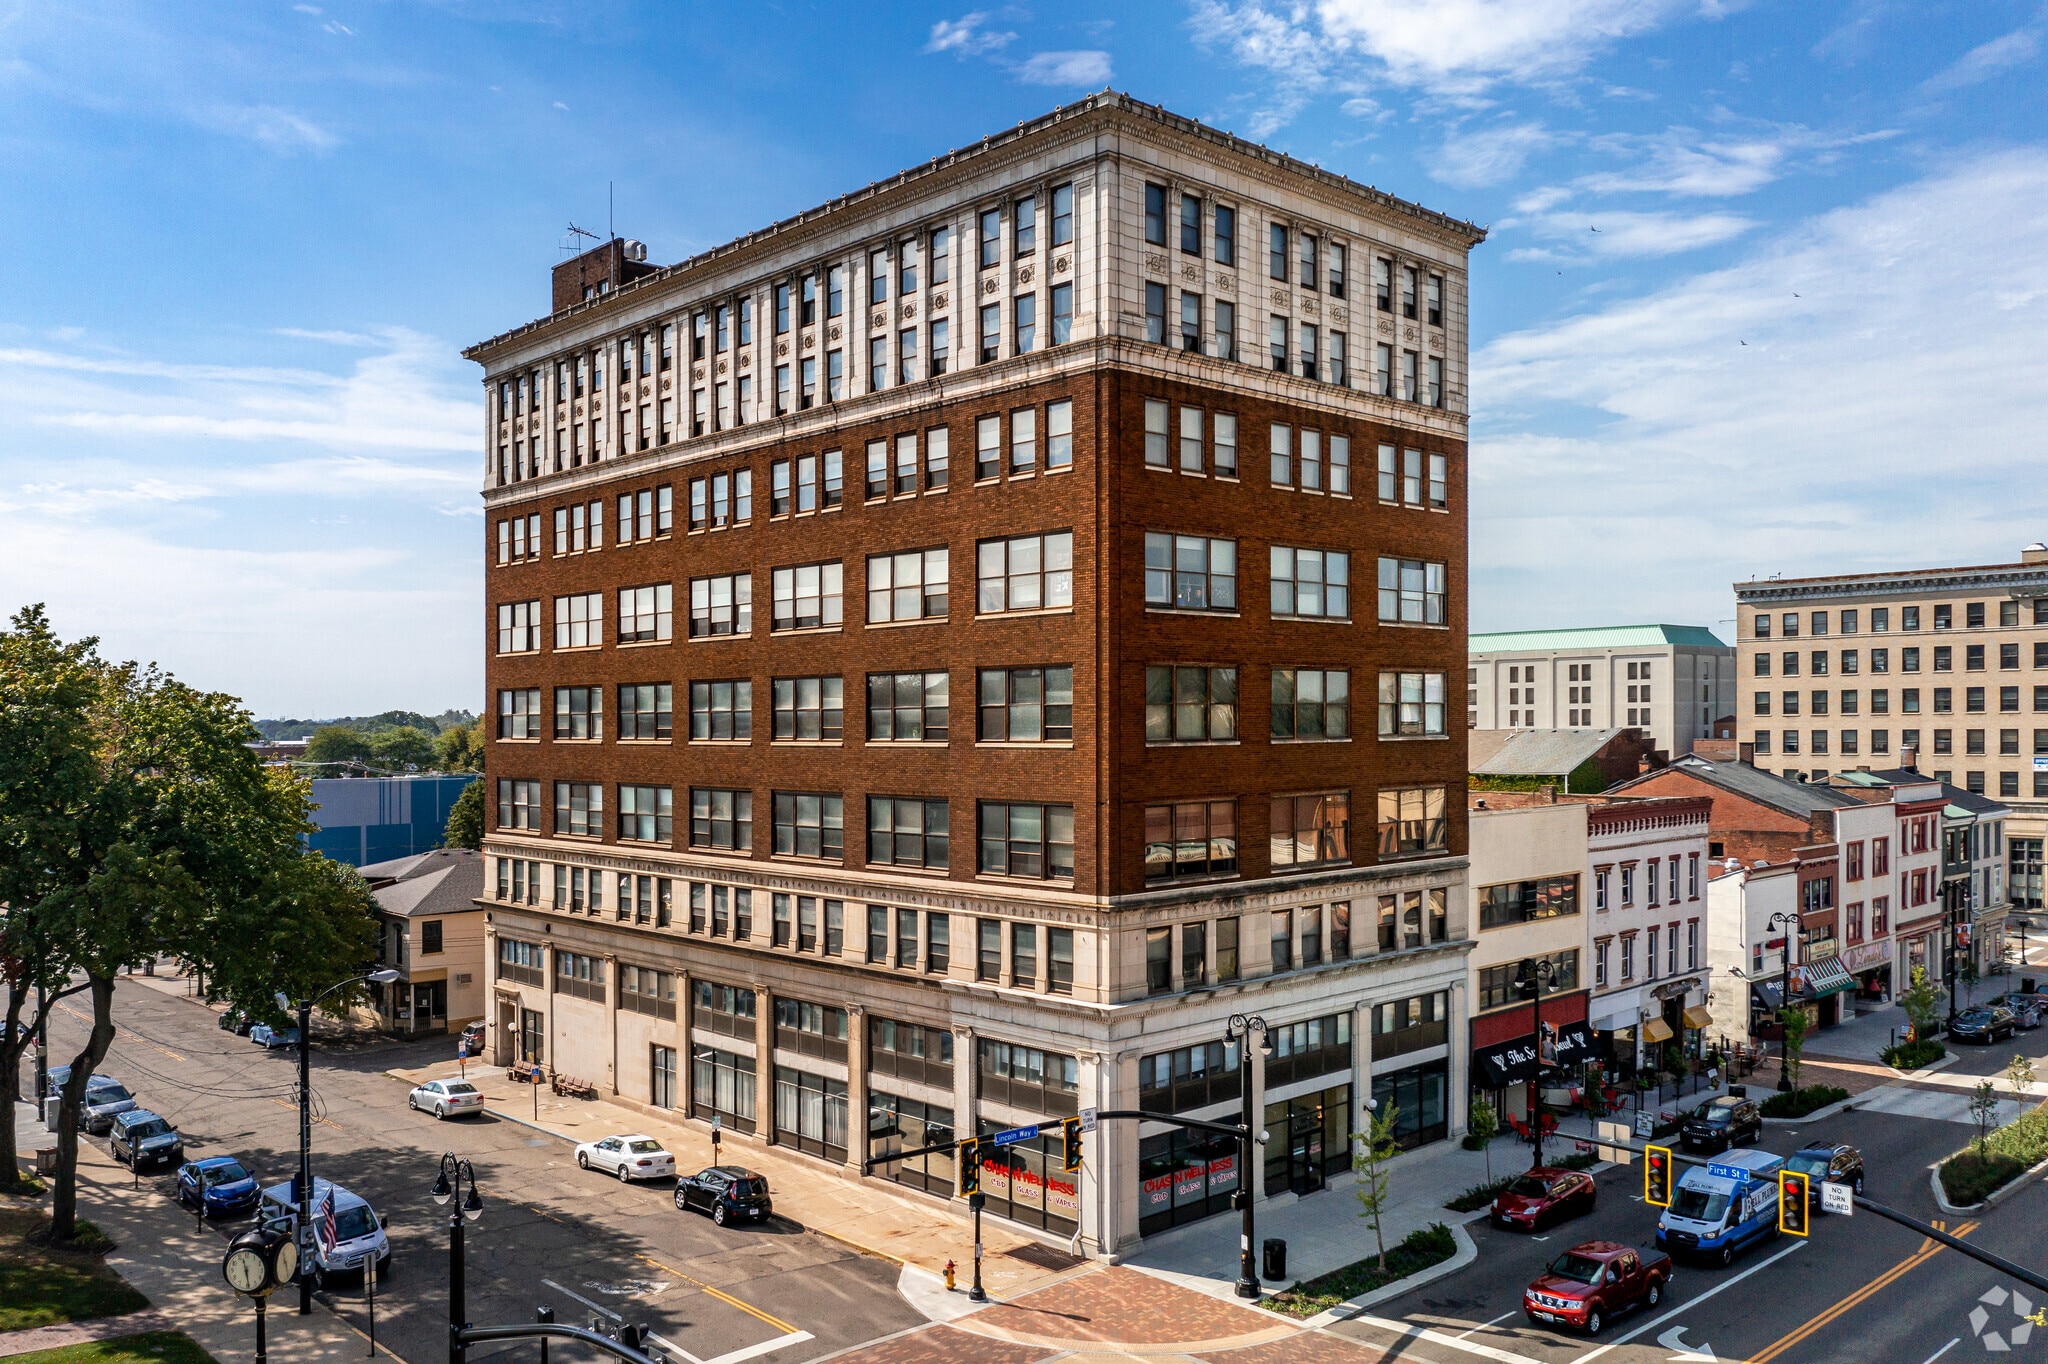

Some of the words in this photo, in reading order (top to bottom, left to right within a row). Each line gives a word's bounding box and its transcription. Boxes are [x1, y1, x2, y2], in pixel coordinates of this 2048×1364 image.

[1507, 1049, 1526, 1065] The
[995, 1132, 1017, 1144] Lincoln
[1019, 1129, 1031, 1138] Way
[1184, 1155, 1233, 1180] WELLNESS
[1709, 1165, 1727, 1176] First
[1731, 1169, 1740, 1178] St
[1022, 1170, 1075, 1196] WELLNESS
[1151, 1192, 1168, 1204] CBD
[1178, 1181, 1201, 1195] GLASS
[1217, 1170, 1238, 1183] VAPES
[990, 1178, 1006, 1188] CBD
[1016, 1185, 1038, 1198] GLASS
[1055, 1196, 1078, 1209] VAPES
[1828, 1194, 1846, 1202] TURN
[1836, 1203, 1849, 1211] RED
